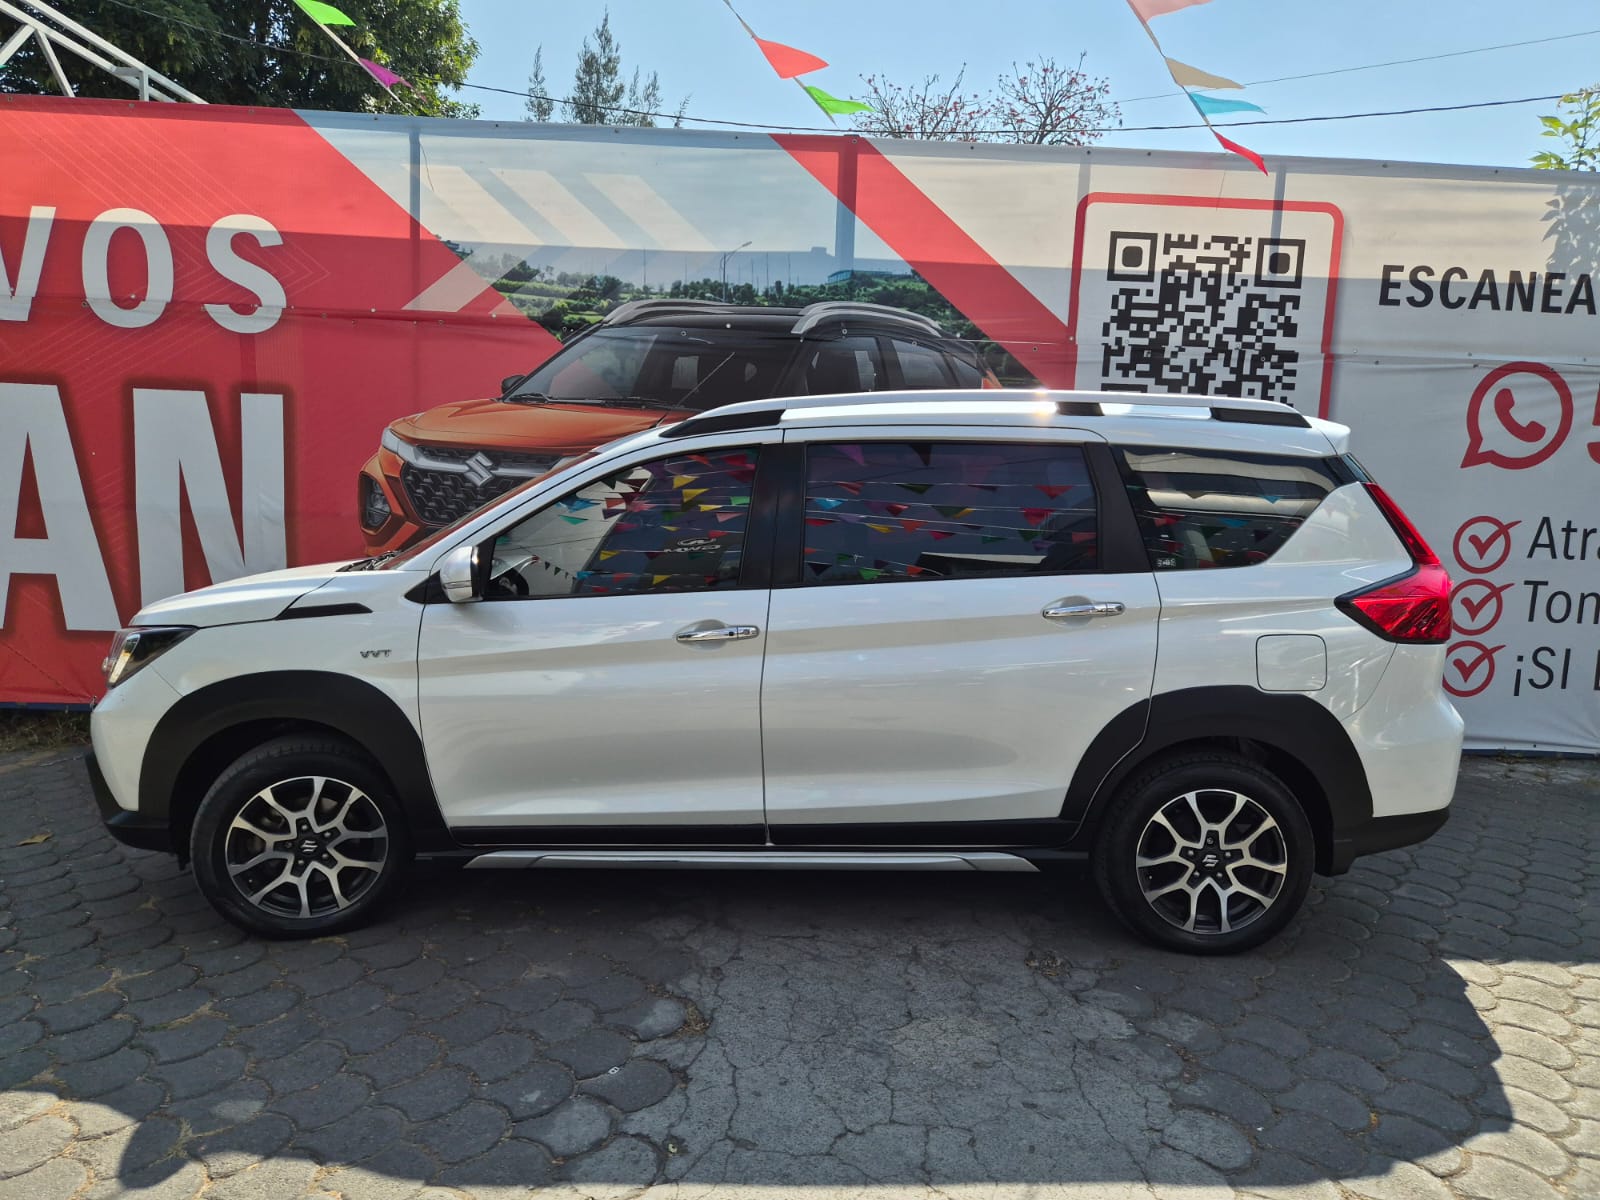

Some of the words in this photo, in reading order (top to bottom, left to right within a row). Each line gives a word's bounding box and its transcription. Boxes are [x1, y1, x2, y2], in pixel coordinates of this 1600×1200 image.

[1379, 264, 1597, 316] ESCANEA
[0, 382, 287, 631] AN
[1527, 516, 1600, 561] Atr
[1513, 646, 1571, 697] ¡SI
